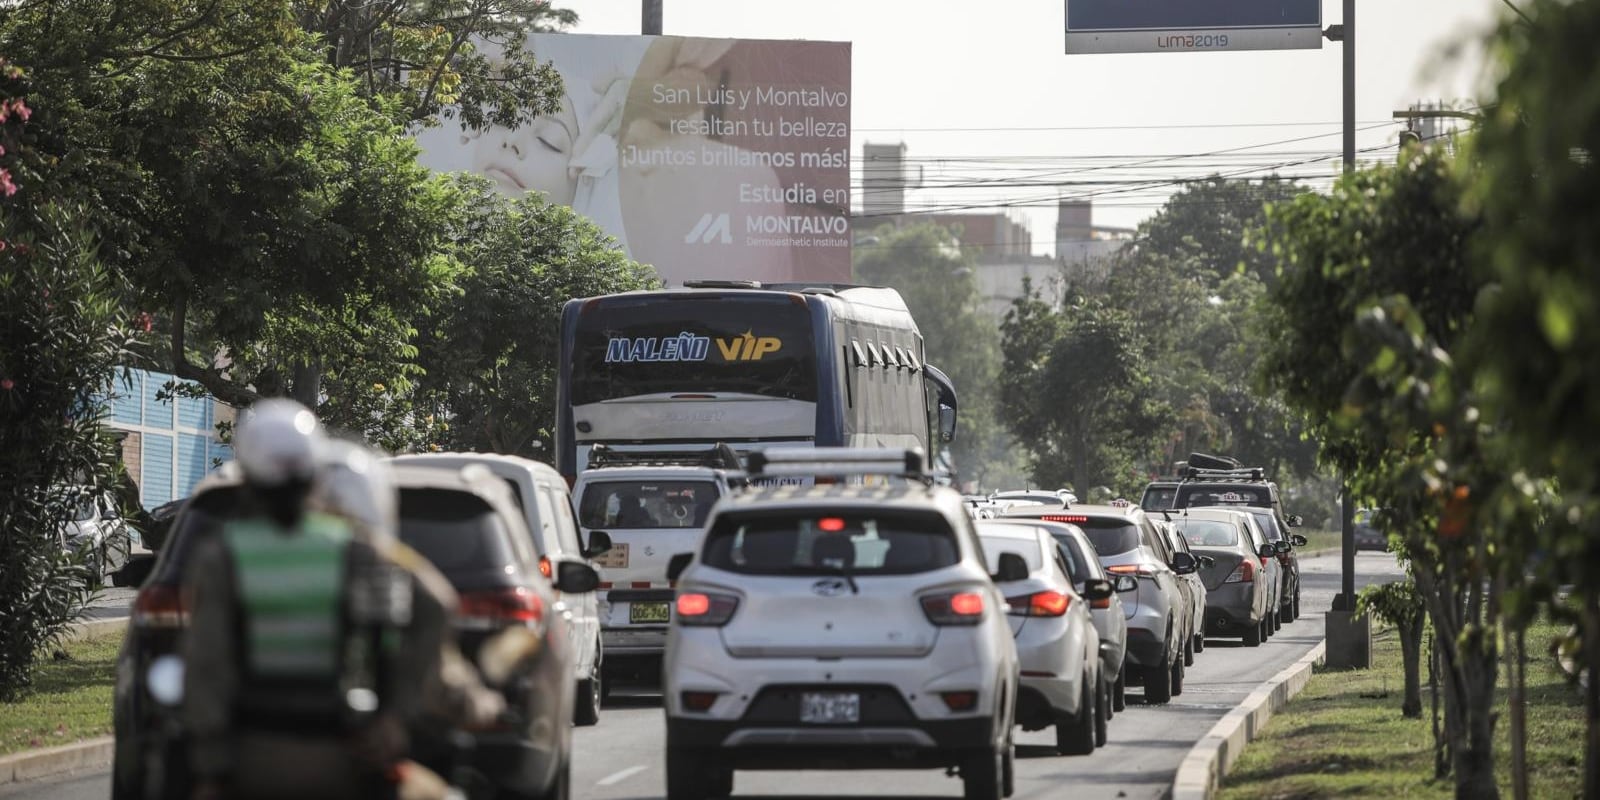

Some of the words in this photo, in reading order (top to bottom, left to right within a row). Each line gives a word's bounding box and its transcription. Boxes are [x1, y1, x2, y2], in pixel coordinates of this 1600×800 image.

[652, 83, 690, 104] San
[697, 83, 736, 105] Luis
[738, 89, 752, 110] y
[756, 85, 848, 108] Montalvo
[670, 114, 748, 136] resaltan
[752, 118, 774, 137] tu
[780, 116, 847, 138] belleza
[622, 144, 697, 168] ¡Juntos
[701, 144, 796, 168] brillamos
[800, 147, 848, 168] más!
[740, 183, 817, 204] Estudia
[823, 188, 848, 204] en
[746, 215, 848, 235] MONTALVO
[813, 237, 849, 248] Institute
[605, 331, 710, 362] MALEÑO
[716, 328, 782, 361] VIP
